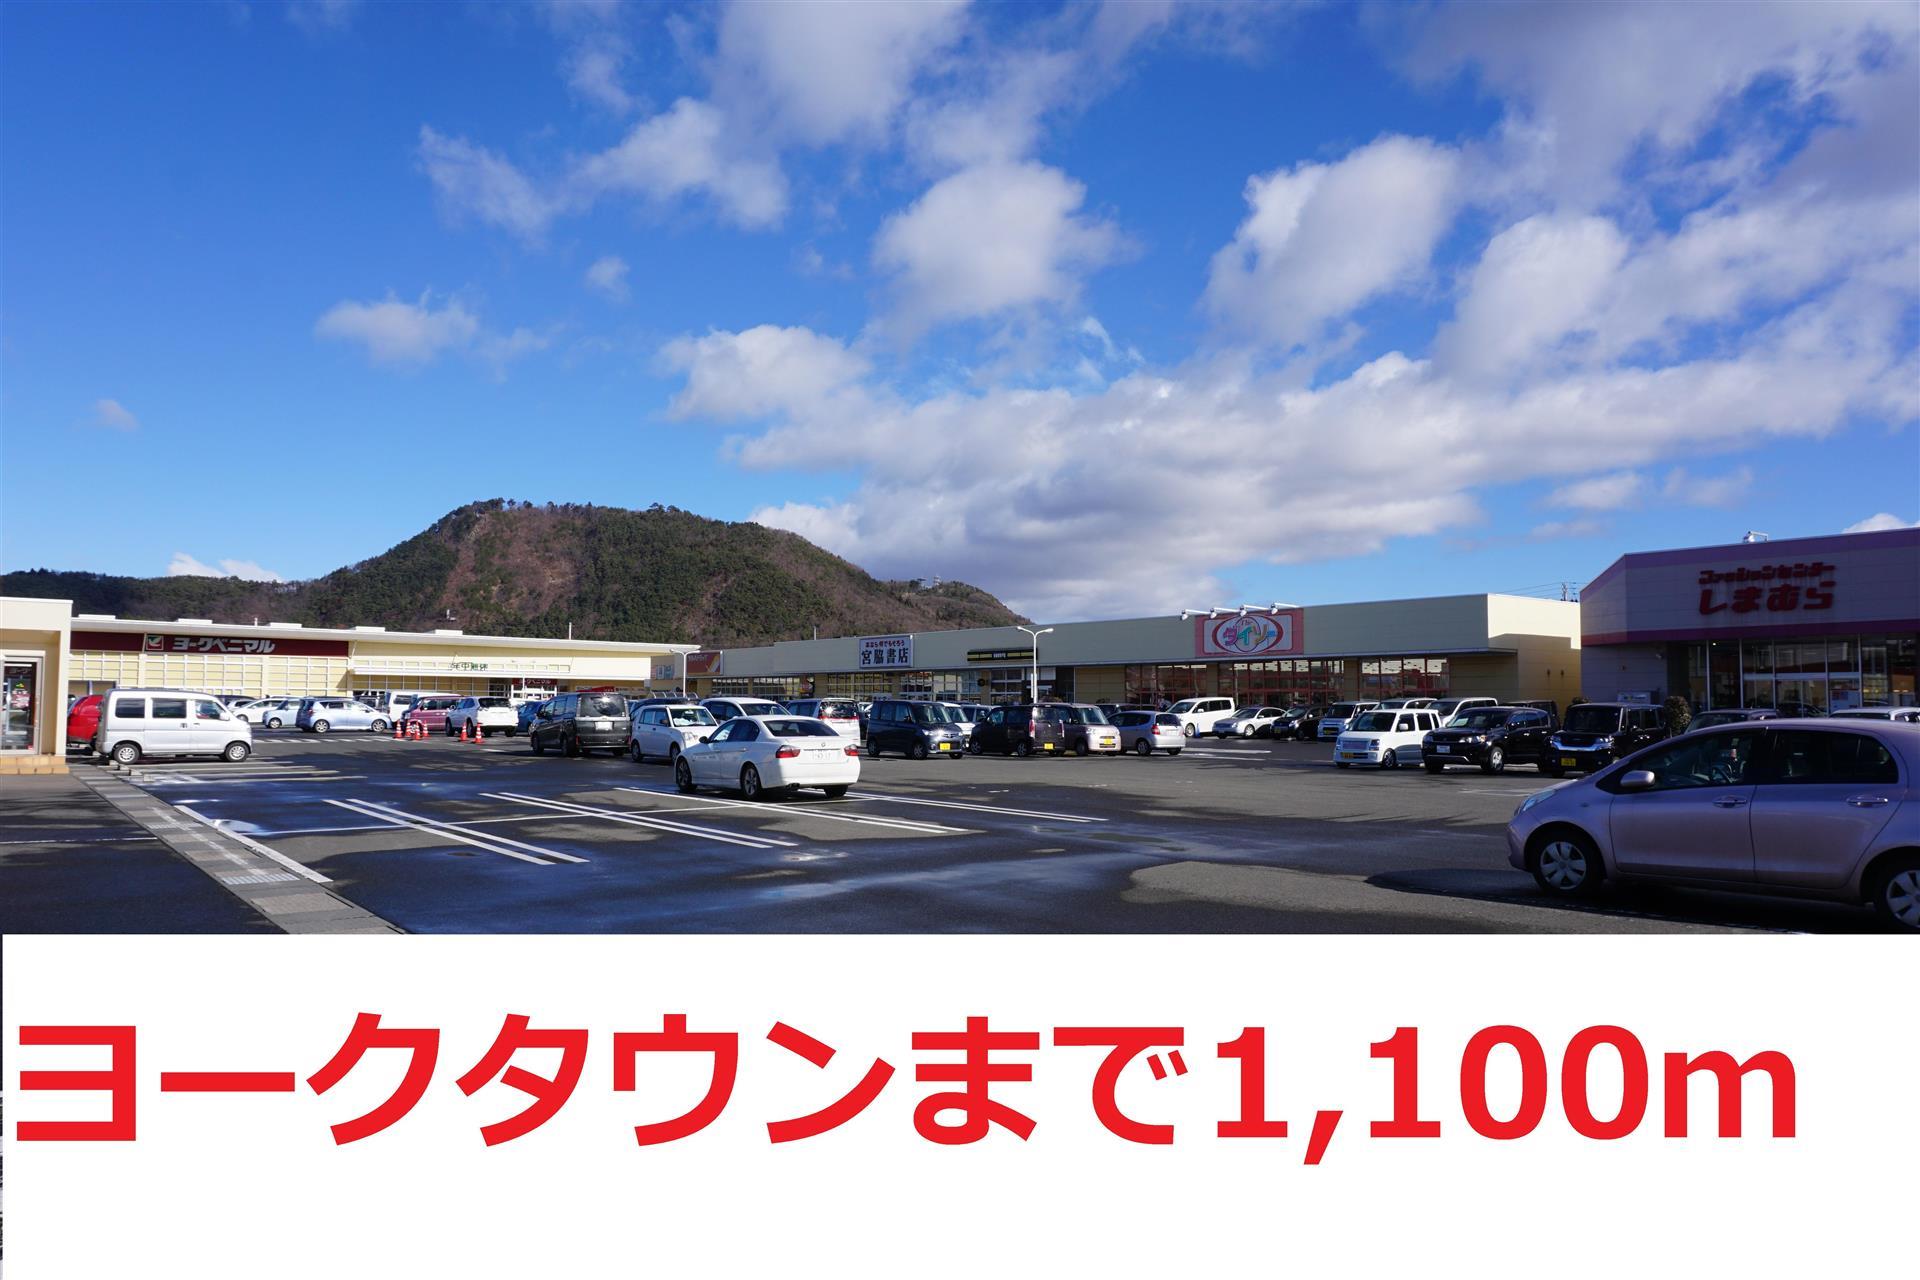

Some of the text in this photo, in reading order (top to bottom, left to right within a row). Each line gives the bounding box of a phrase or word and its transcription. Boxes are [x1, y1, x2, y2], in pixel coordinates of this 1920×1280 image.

[1699, 581, 1836, 615] しまむら
[1222, 624, 1276, 646] ダイソー
[172, 637, 276, 653] ヨークベニマル
[861, 648, 909, 665] 宮脇書店
